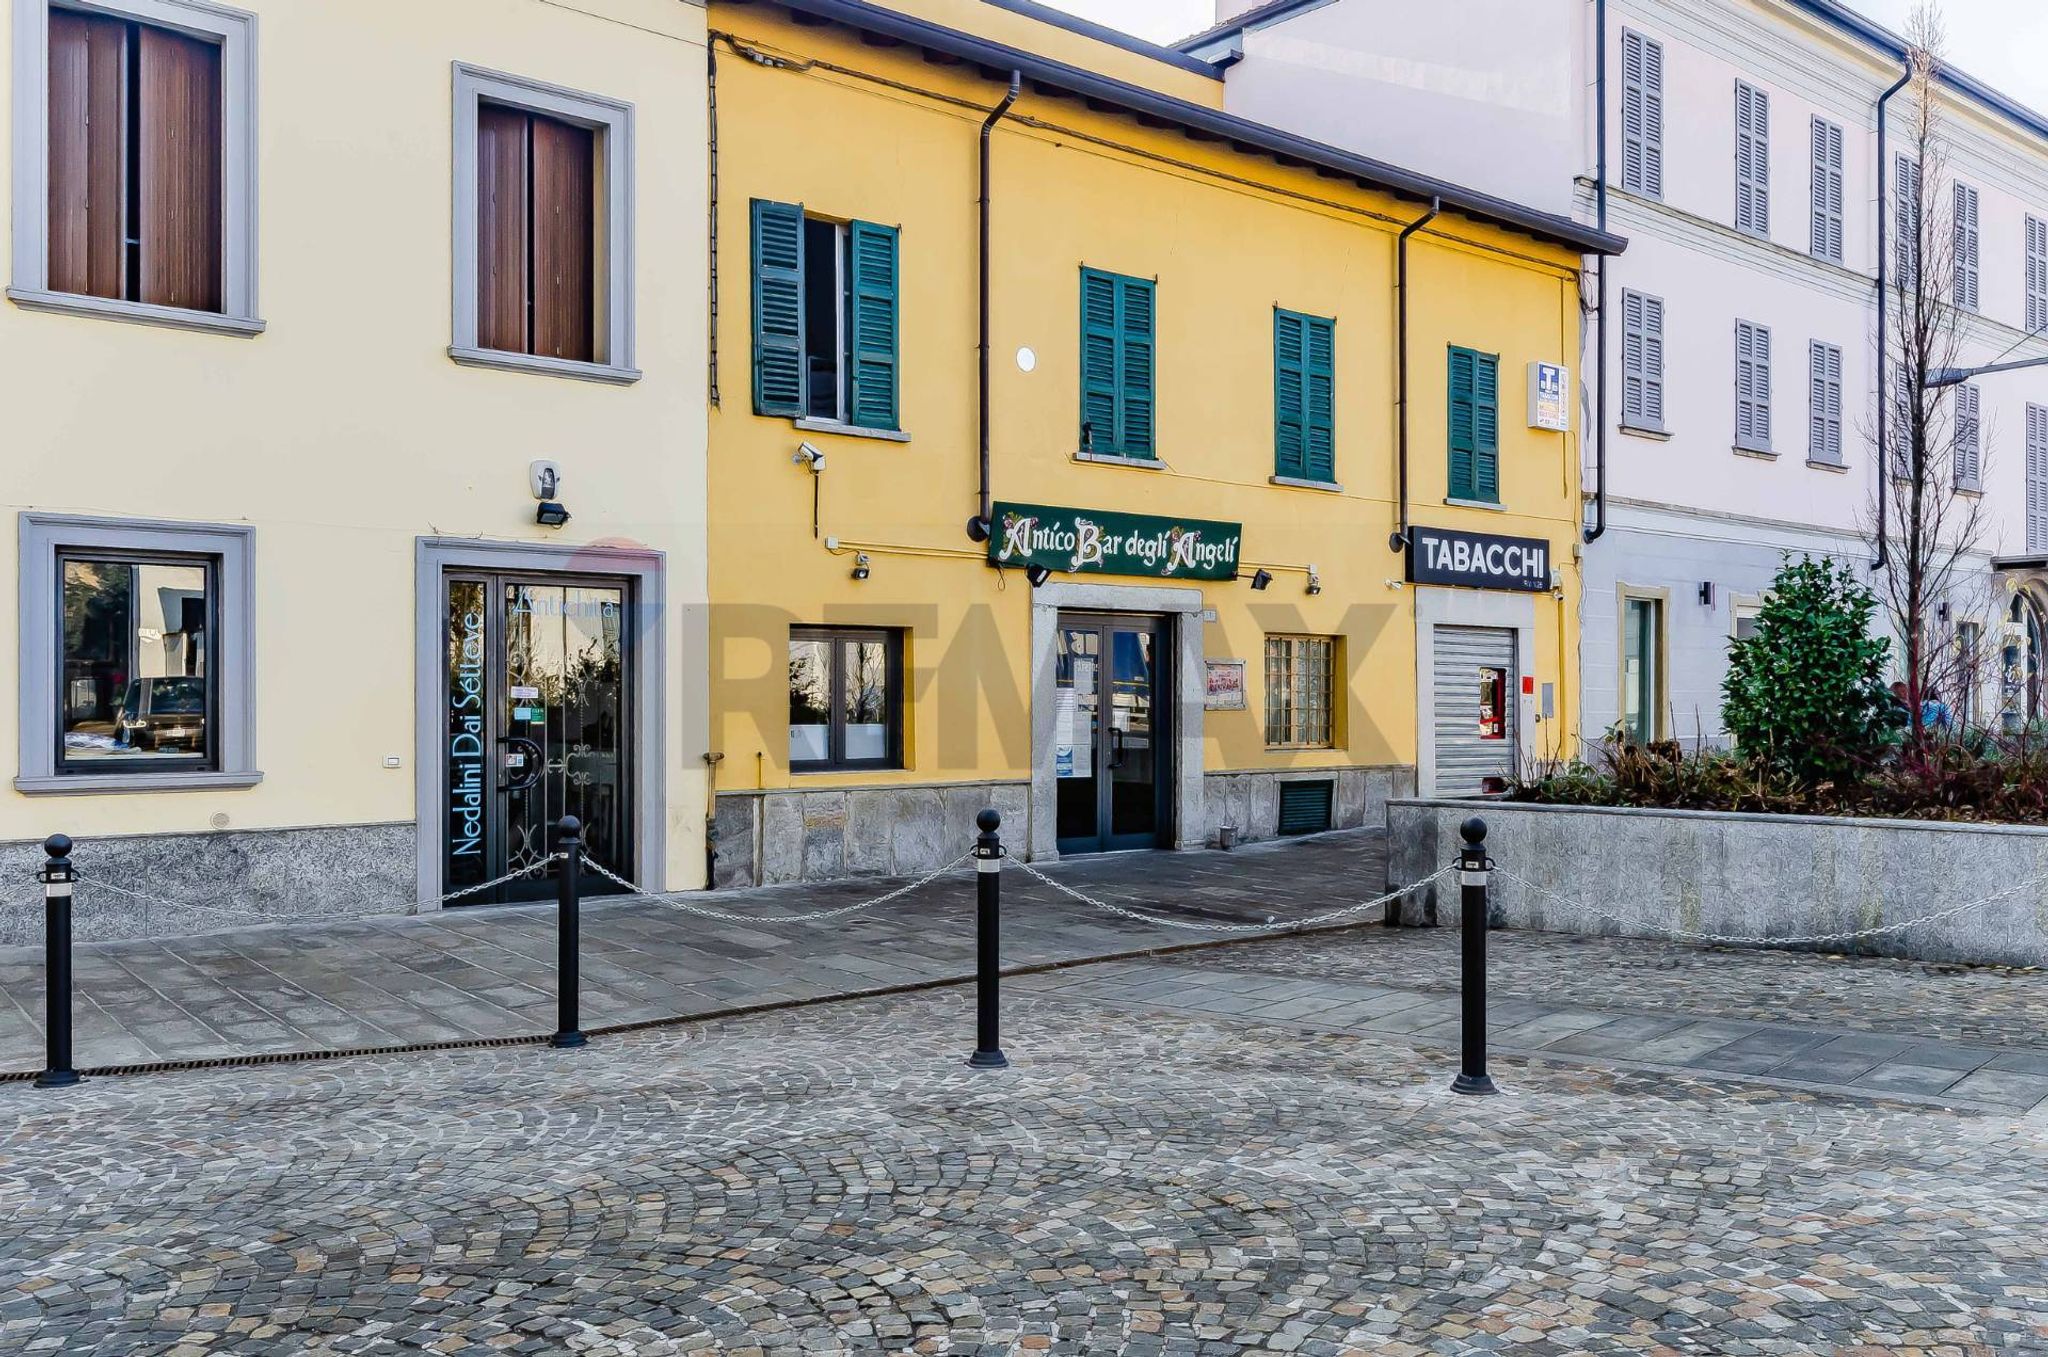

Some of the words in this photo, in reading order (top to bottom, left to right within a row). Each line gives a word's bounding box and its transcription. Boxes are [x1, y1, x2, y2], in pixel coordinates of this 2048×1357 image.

[1070, 517, 1122, 571] Bar
[1422, 537, 1544, 578] TABACCHI
[452, 716, 481, 757] Dai
[452, 764, 481, 855] Nedalini
